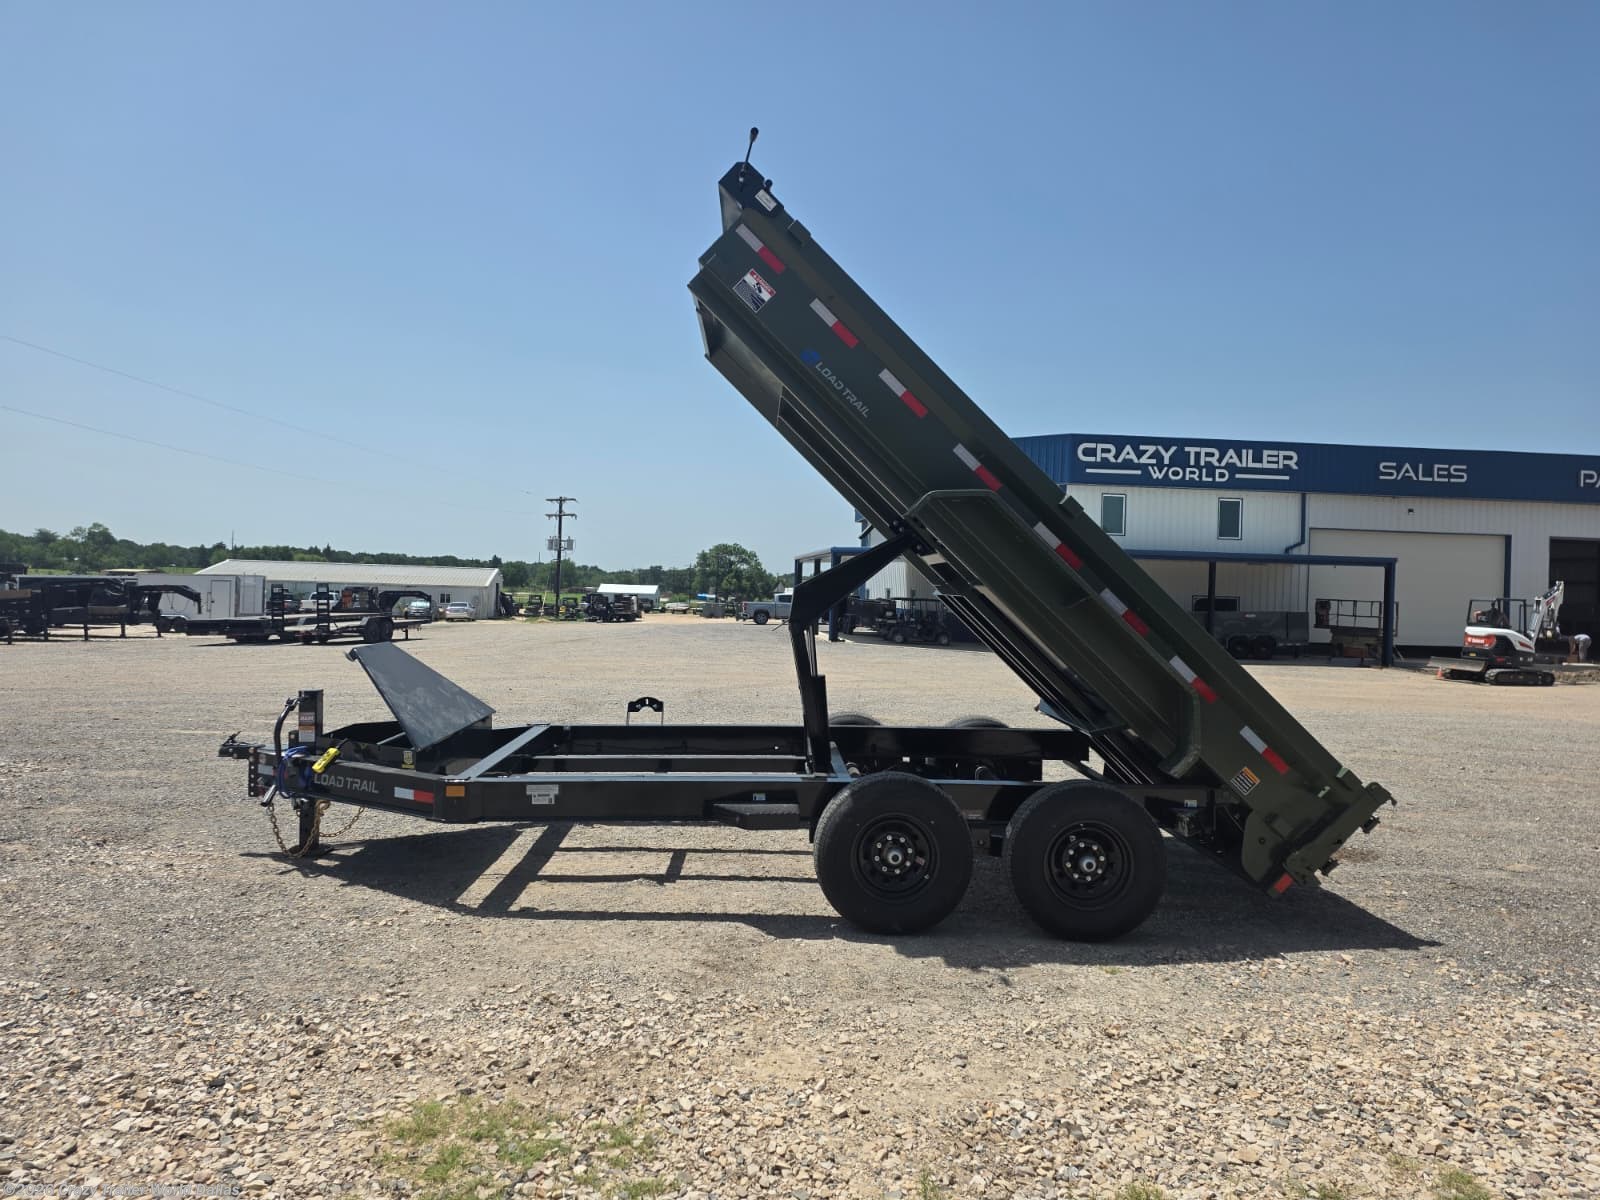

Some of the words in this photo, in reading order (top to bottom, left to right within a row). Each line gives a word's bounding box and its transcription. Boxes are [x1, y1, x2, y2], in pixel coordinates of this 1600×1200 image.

[1077, 443, 1177, 464] CRAZY
[1184, 446, 1298, 469] TRAILER
[1149, 466, 1229, 482] WORLD
[1379, 462, 1467, 482] SALES
